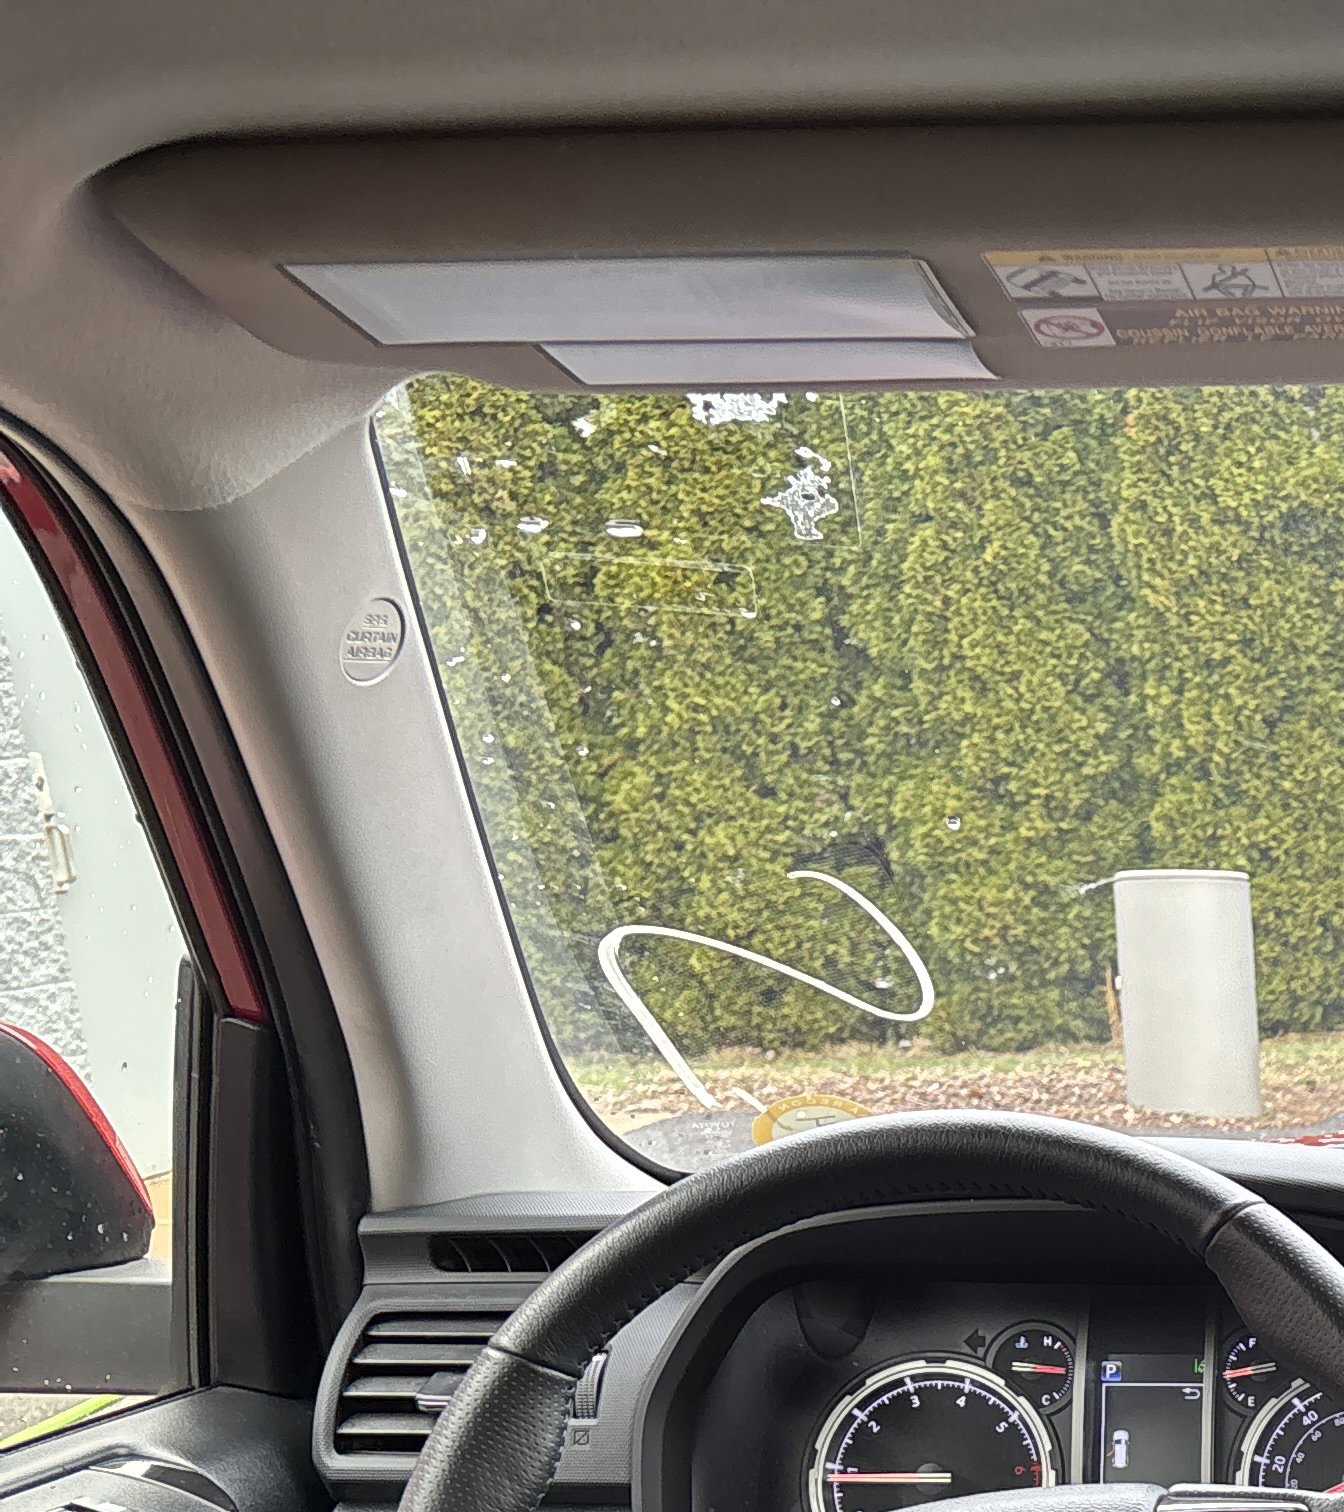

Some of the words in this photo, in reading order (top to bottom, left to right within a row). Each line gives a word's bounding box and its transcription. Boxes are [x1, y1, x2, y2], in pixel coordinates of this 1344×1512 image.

[1216, 306, 1261, 317] BAG
[1042, 1336, 1053, 1347] H
[1248, 1337, 1257, 1348] F
[910, 1396, 921, 1408] 3
[956, 1396, 967, 1408] 4
[1041, 1394, 1051, 1405] C
[1247, 1395, 1256, 1407] E
[1301, 1410, 1319, 1427] 40
[867, 1421, 881, 1434] 2
[995, 1422, 1008, 1433] 5
[1271, 1456, 1286, 1473] 20
